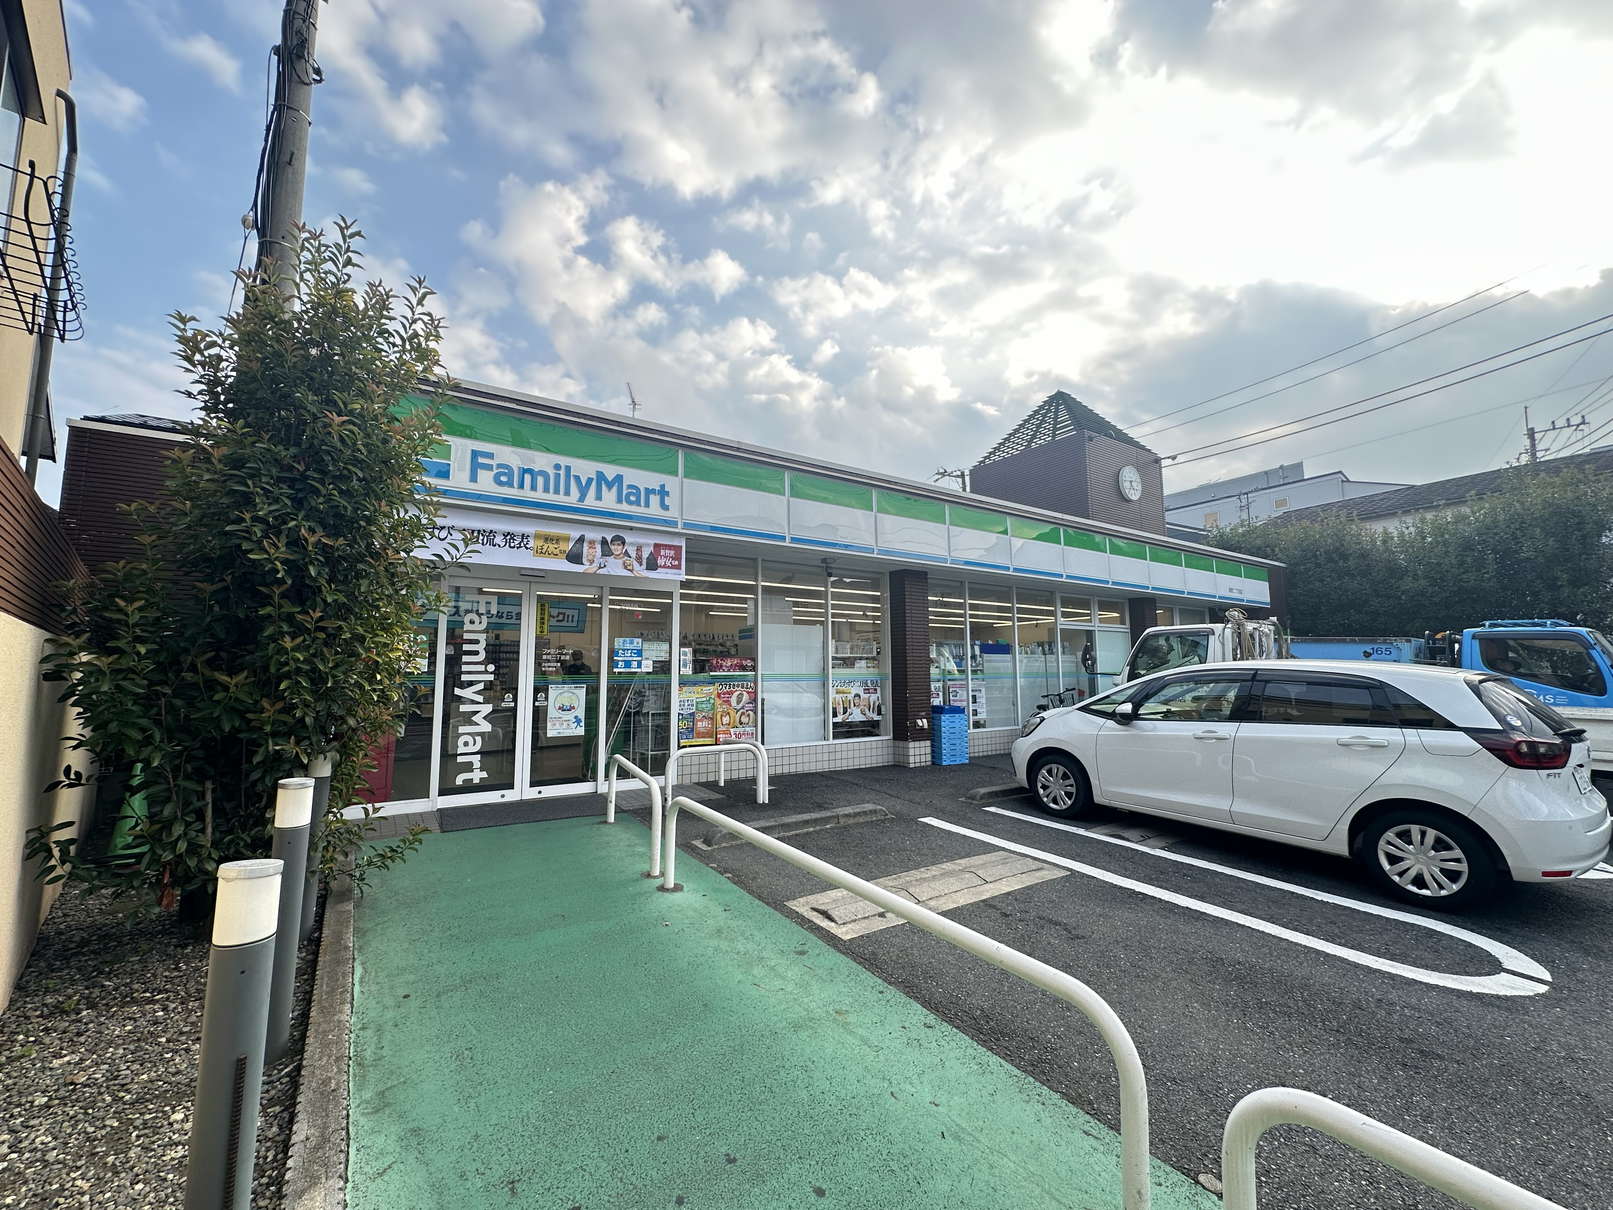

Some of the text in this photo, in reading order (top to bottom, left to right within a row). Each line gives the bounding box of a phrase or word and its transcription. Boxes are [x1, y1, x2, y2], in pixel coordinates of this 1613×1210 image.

[468, 448, 670, 511] FamilyMart
[618, 649, 638, 657] たばこ
[1371, 646, 1392, 655] 165
[454, 594, 498, 785] FamilyMart
